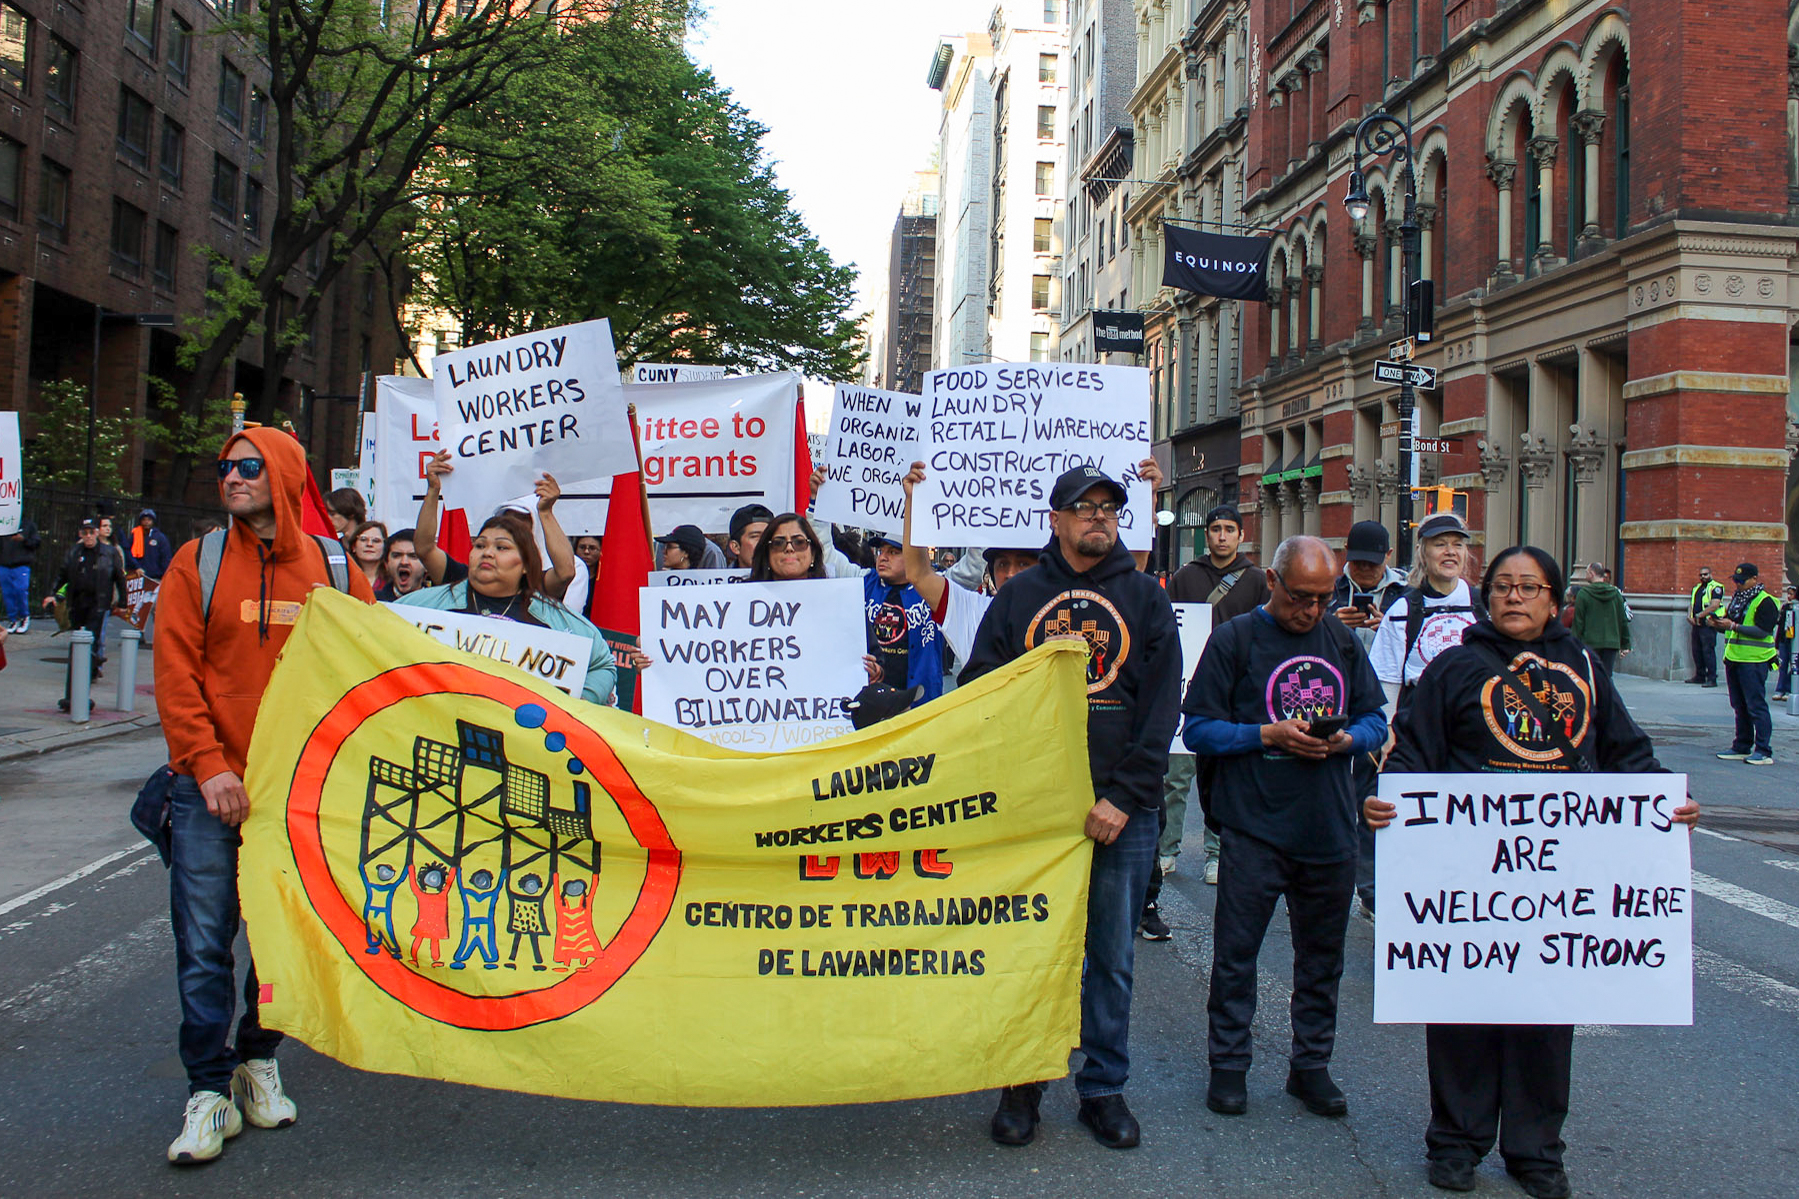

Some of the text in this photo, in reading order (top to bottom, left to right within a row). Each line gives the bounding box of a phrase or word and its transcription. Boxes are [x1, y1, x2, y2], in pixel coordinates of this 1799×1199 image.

[1175, 251, 1258, 273] EQUINOX
[1119, 329, 1143, 340] method
[448, 336, 566, 388] LAUNDRY
[638, 368, 724, 382] CUNY STUDENTS
[1384, 369, 1401, 379] ONE
[933, 371, 988, 393] FOOD
[457, 378, 585, 423] WORKERS
[841, 390, 891, 414] WHEN
[931, 392, 1043, 419] LAUNDRY
[458, 413, 579, 458] CENTER
[732, 411, 766, 438] to
[1415, 440, 1450, 453] Bond St
[644, 449, 757, 485] grants
[828, 463, 853, 483] WE
[940, 476, 1044, 498] WORKES
[661, 599, 801, 629] MAY DAY
[1035, 591, 1122, 625] LAUNDRY WORKERS CENTER
[518, 647, 576, 680] NOT
[659, 635, 801, 664] WORKERS
[706, 666, 788, 692] OVER
[1551, 663, 1580, 684] CENTER
[812, 754, 936, 801] LAUNDRY
[755, 791, 998, 848] WORKERS CENTER
[1401, 791, 1672, 832] IMMIGRANTS
[1492, 836, 1559, 873] ARE
[685, 893, 1049, 929] CENTRO DE TRABAJADORES
[1404, 883, 1686, 924] WELCOME HERE
[758, 949, 986, 977] DE LAVANDERIAS
[1387, 932, 1665, 973] MAY DAY STRONG
